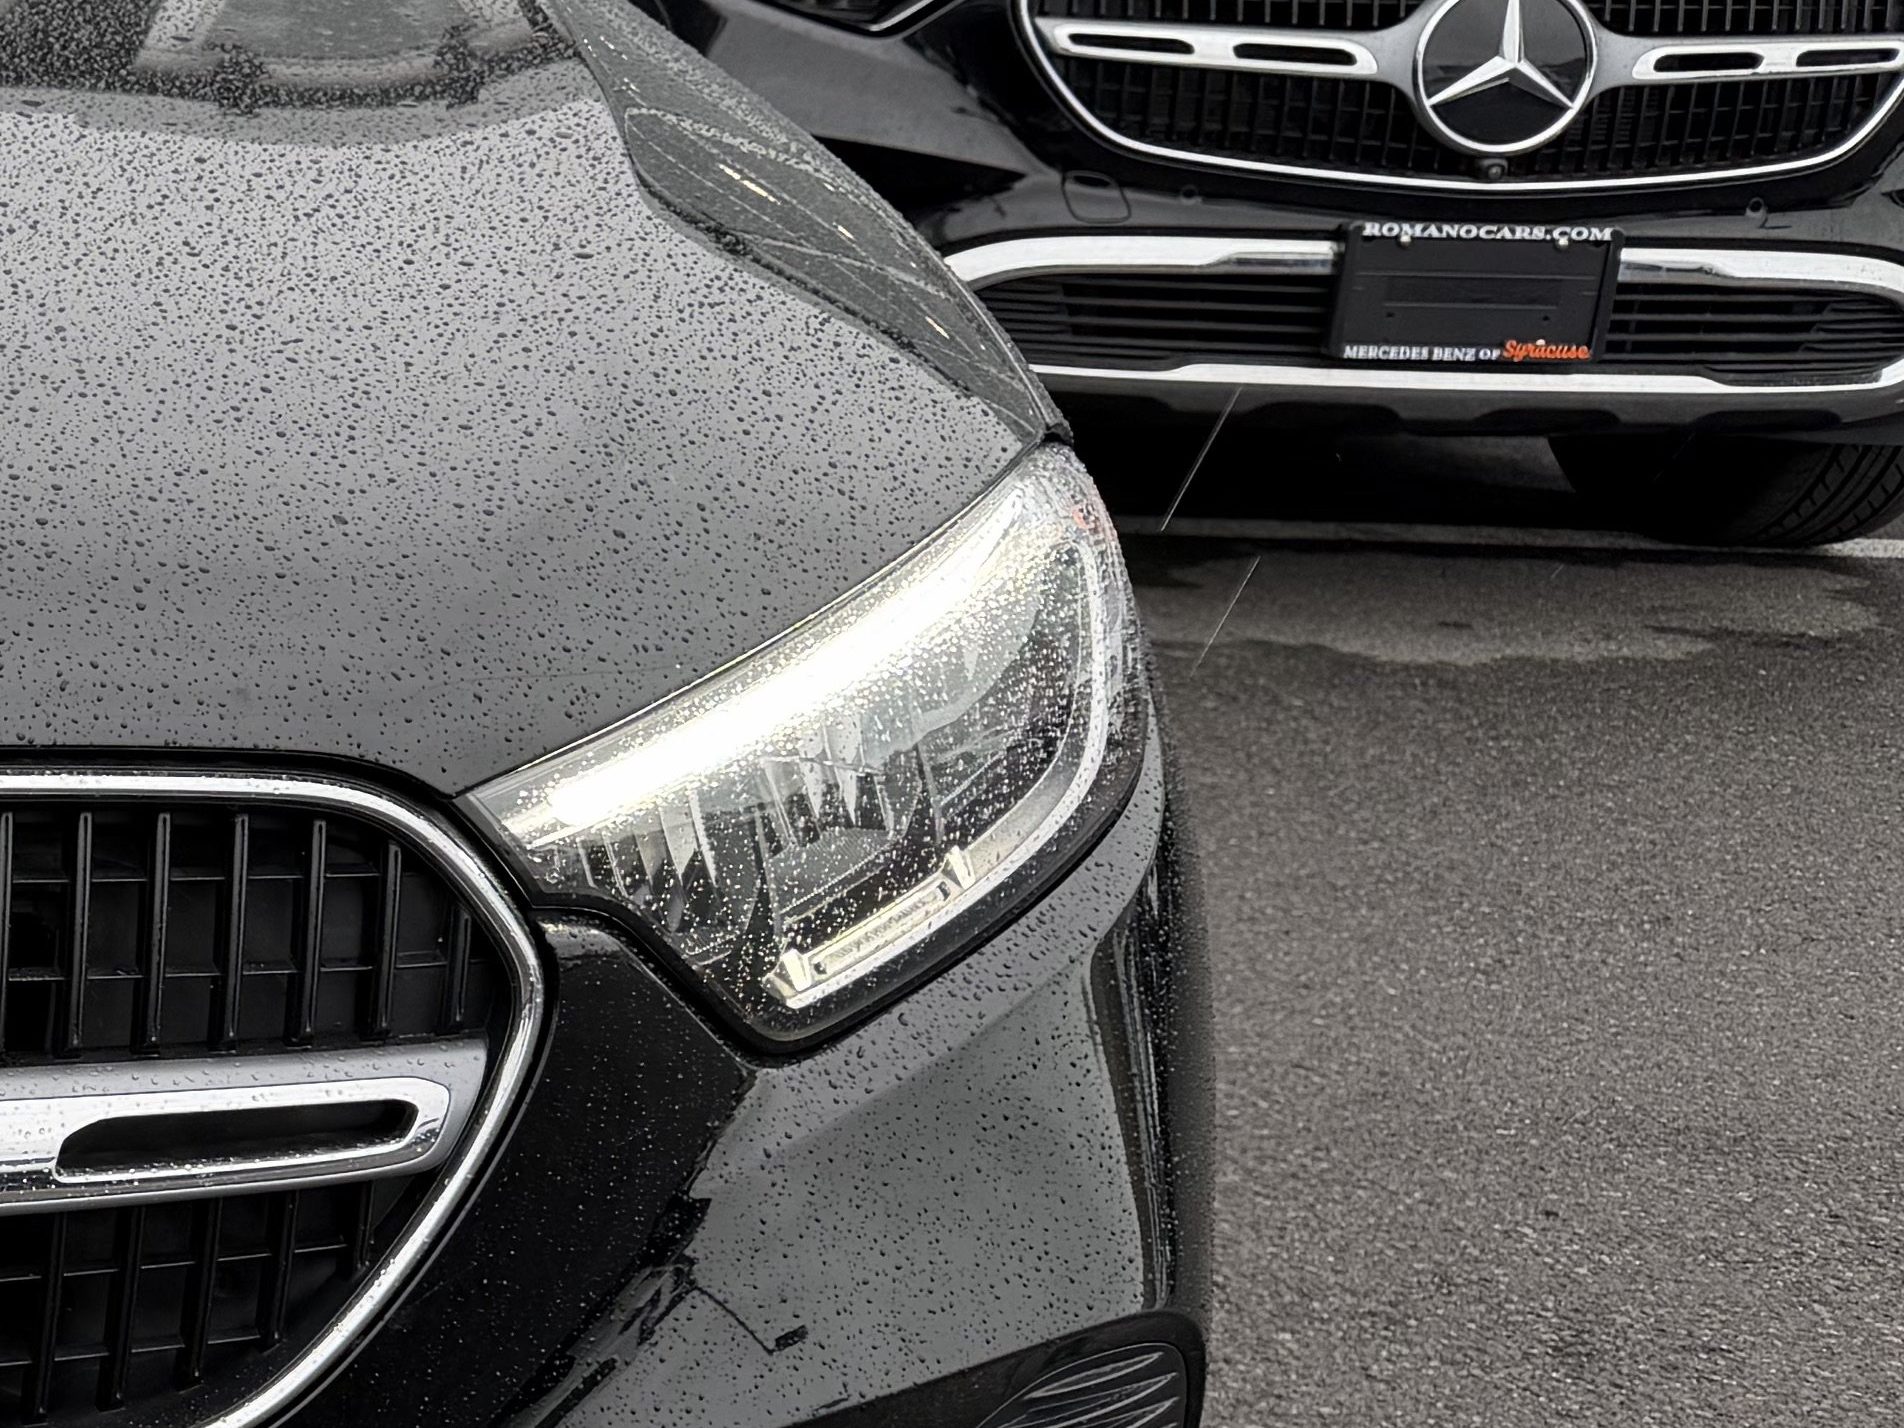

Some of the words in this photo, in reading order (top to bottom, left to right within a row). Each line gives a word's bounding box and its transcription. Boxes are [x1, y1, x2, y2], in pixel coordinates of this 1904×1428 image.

[1362, 222, 1613, 241] ROMANOCARS.COM
[1343, 344, 1429, 360] MERCEDES
[1432, 346, 1476, 362] BENZ
[1502, 340, 1591, 362] Syracuse
